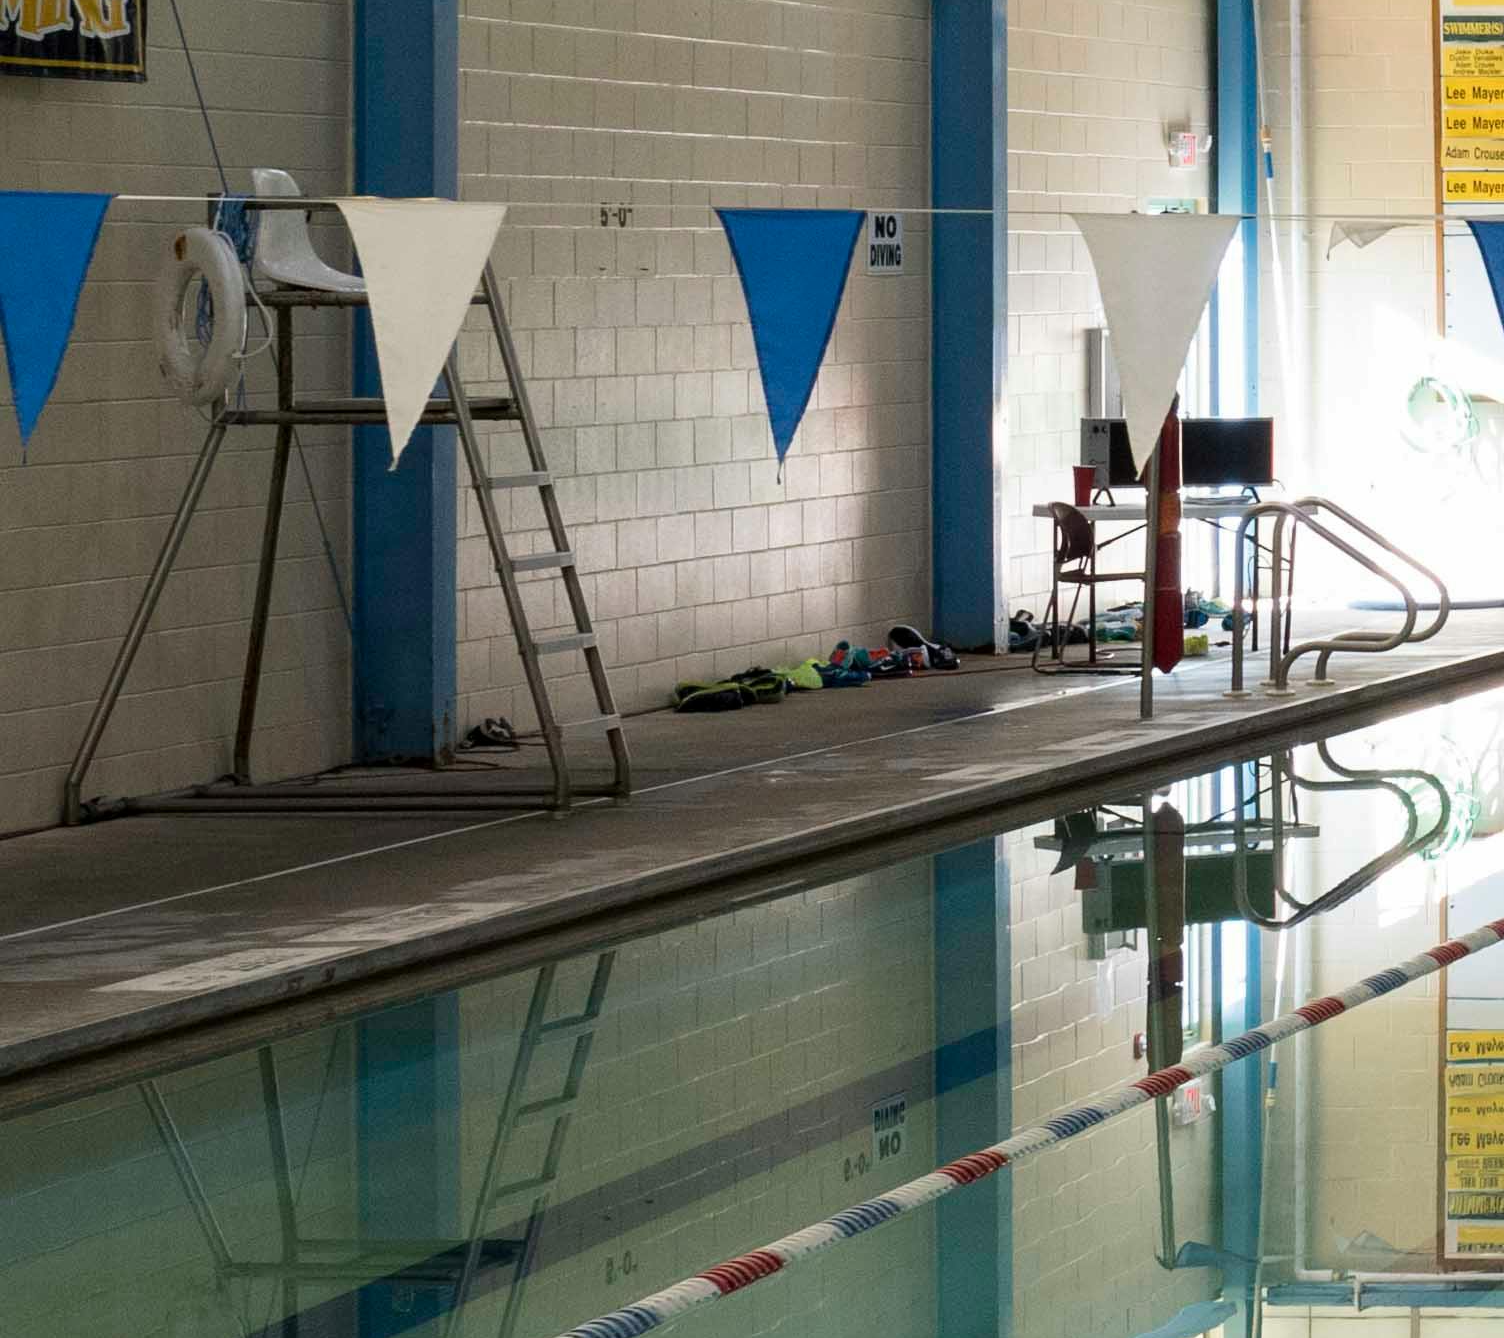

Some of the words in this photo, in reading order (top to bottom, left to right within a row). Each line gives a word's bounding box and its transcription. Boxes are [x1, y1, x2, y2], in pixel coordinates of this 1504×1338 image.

[1443, 21, 1504, 36] SWIMMER(S)
[1446, 87, 1466, 99] Lee
[1473, 87, 1504, 103] Mayer
[1446, 117, 1466, 130] Lee
[1473, 117, 1504, 133] Mayer
[1446, 147, 1470, 159] Adam
[1447, 180, 1466, 193] Lee
[1473, 180, 1504, 197] Mayer
[874, 215, 897, 238] NO
[870, 244, 901, 266] DIVING
